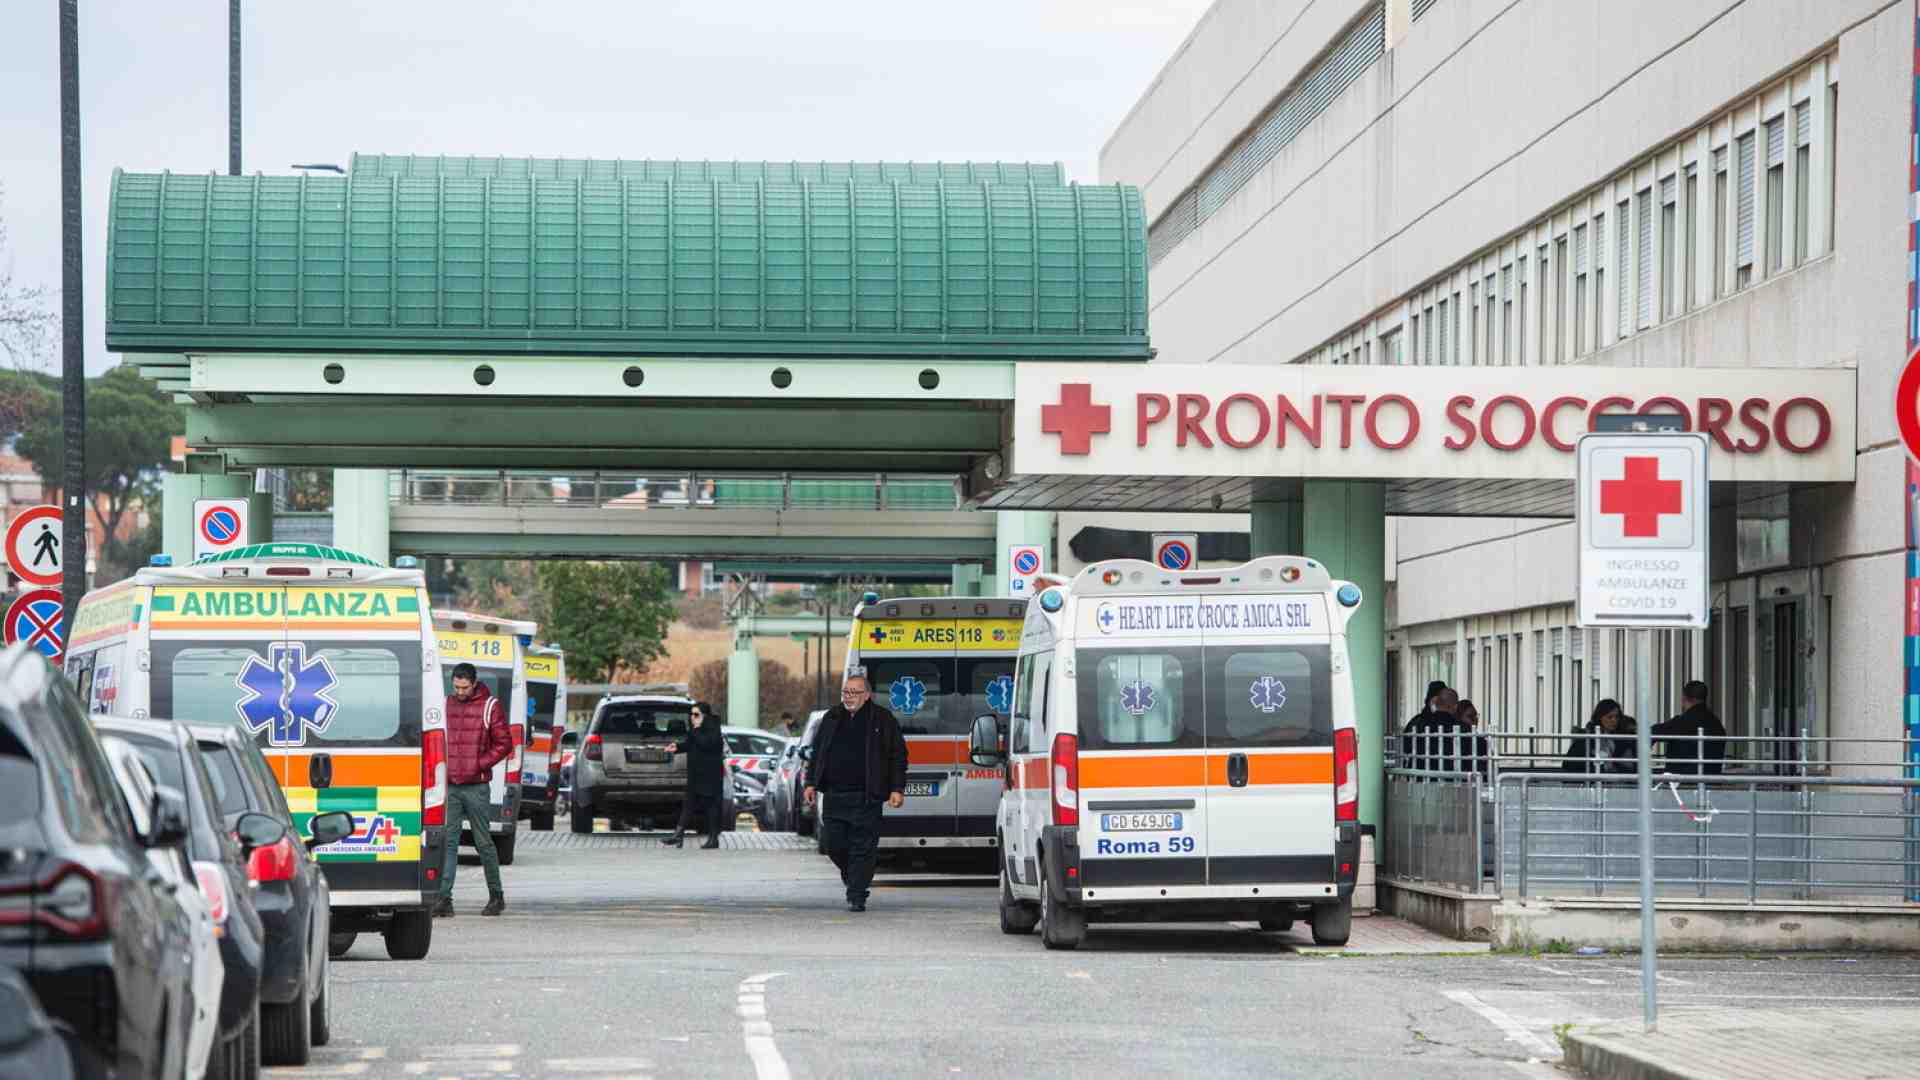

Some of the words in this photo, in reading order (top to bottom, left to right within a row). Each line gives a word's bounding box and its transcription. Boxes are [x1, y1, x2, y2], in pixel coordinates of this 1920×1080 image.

[1136, 392, 1420, 450] PRONTO
[1607, 560, 1680, 571] INGRESSO
[1598, 578, 1688, 589] AMBULANZE
[180, 591, 392, 617] AMBULANZA
[1609, 597, 1655, 609] COVID
[1661, 597, 1677, 609] 19
[1119, 605, 1163, 630] HEART
[1166, 605, 1194, 629] LIFE
[1197, 604, 1239, 628] CROCE
[1243, 604, 1283, 627] AMICA
[1286, 603, 1311, 627] SRL
[913, 628, 955, 643] ARES
[959, 628, 982, 643] 118
[438, 640, 458, 651] AZIO
[471, 640, 500, 656] 118
[965, 770, 1004, 780] AMBU
[1097, 839, 1160, 855] Roma
[1168, 836, 1194, 853] 59
